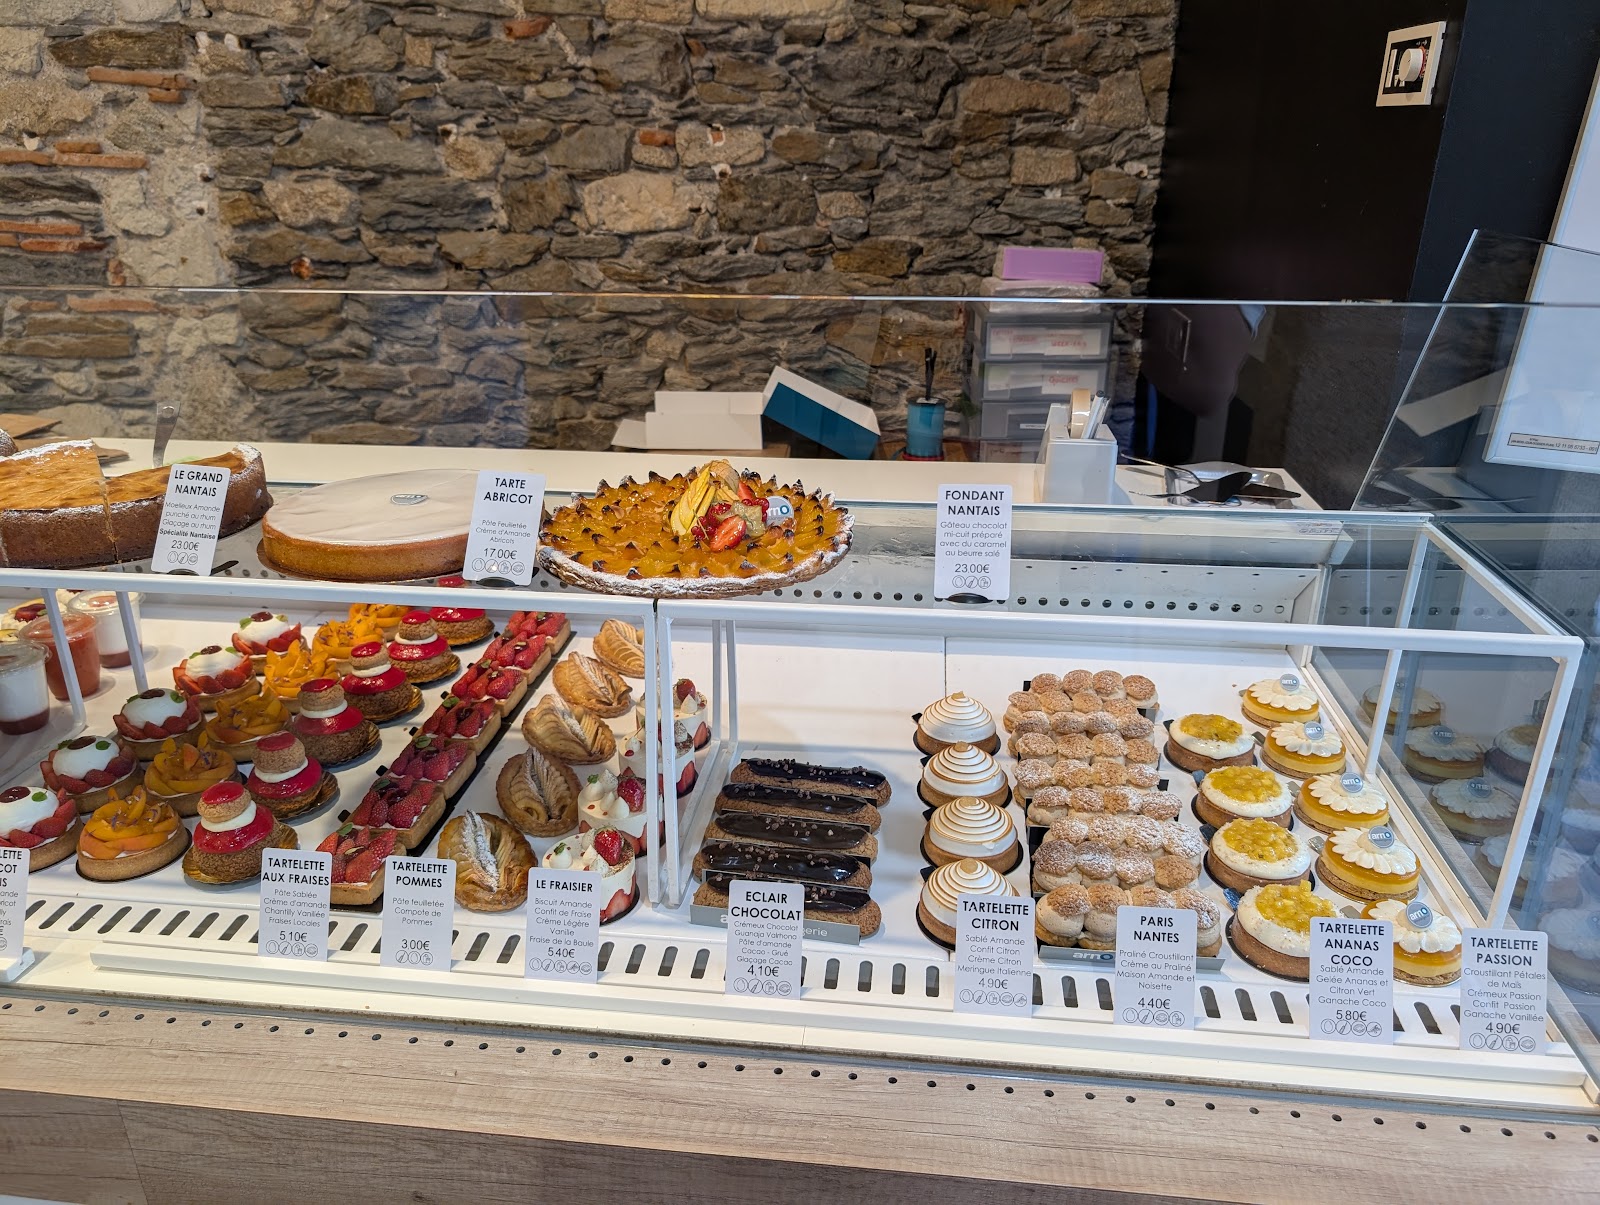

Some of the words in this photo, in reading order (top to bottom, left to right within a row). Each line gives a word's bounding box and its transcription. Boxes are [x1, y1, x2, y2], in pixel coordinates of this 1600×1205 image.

[175, 470, 184, 479] LE
[187, 471, 223, 482] GRAND
[495, 478, 526, 489] TARTE
[175, 485, 217, 497] NANTAIS
[946, 490, 1004, 500] FONDANT
[484, 492, 533, 504] ABRICOT
[193, 504, 220, 512] Amande
[948, 506, 1000, 515] NANTAIS
[163, 519, 189, 528] Glaçage
[498, 521, 527, 529] Feuilletée
[940, 521, 970, 529] Gâteau
[160, 528, 188, 536] Spécialité
[190, 532, 215, 540] Nantaise
[498, 530, 531, 538] d'Amande
[171, 540, 200, 551] 2300€
[490, 536, 514, 544] Abricots
[955, 564, 990, 573] 23.00€
[268, 858, 325, 870] TARTELETTE
[393, 861, 447, 873] TARTELETTE
[262, 872, 285, 882] AUX
[289, 874, 329, 886] FRAISES
[396, 876, 442, 888] POMMES
[536, 880, 546, 889] LE
[550, 881, 593, 892] FRAISIER
[293, 890, 317, 898] Sablée
[746, 891, 788, 904] ECLAIR
[264, 898, 288, 906] Crème
[290, 900, 327, 908] d'amande
[411, 899, 444, 908] feuilletée
[559, 900, 592, 908] Amande
[963, 901, 1029, 916] TARTELETTE
[265, 907, 295, 916] Chantilly
[297, 910, 325, 918] Vanillée
[394, 907, 429, 916] Compote
[535, 907, 557, 915] Confit
[571, 910, 592, 918] Fraise
[731, 906, 801, 920] CHOCOLAT
[1410, 908, 1428, 920] arno
[294, 919, 320, 927] Locales
[402, 917, 432, 926] Pommes
[536, 917, 561, 925] Crème
[564, 919, 589, 928] Légère
[734, 921, 764, 929] Crémeux
[766, 923, 798, 931] Chocolat
[972, 918, 1018, 931] CITRON
[1140, 916, 1174, 927] PARIS
[550, 928, 574, 936] Vanille
[735, 930, 764, 938] Guanaja
[1319, 922, 1384, 935] TARTELETTE
[280, 930, 307, 942] 510€
[529, 936, 550, 944] Fraise
[574, 939, 594, 947] Baule
[966, 934, 988, 943] Sablé
[990, 937, 1025, 946] Amande
[1134, 931, 1179, 943] NANTES
[756, 940, 792, 948] d'amande
[1324, 939, 1379, 951] ANANAS
[1471, 937, 1538, 950] TARTELETTE
[970, 945, 994, 953] Confit
[996, 947, 1020, 955] Citron
[1120, 950, 1146, 958] Praliné
[1149, 952, 1194, 961] Croustillant
[737, 956, 766, 964] Glaçage
[768, 958, 792, 966] Cacao
[968, 955, 995, 964] Crème
[998, 957, 1021, 966] Citron
[1073, 952, 1113, 960] arno
[1331, 955, 1373, 966] COCO
[1476, 953, 1532, 966] PASSION
[957, 965, 995, 974] Meringue
[997, 968, 1031, 977] Italienne
[1121, 960, 1148, 968] Crème
[1164, 962, 1191, 971] Praliné
[1320, 965, 1344, 973] Sablé
[1346, 966, 1384, 975] Amande
[1117, 970, 1145, 978] Maison
[1148, 972, 1184, 981] Amande
[1464, 968, 1512, 978] Croustillant
[1514, 970, 1546, 980] Pétales
[1138, 982, 1172, 990] Noisette
[1316, 975, 1342, 983] Gelée
[1345, 977, 1377, 986] Ananas
[1330, 986, 1354, 995] Citron
[1357, 988, 1375, 996] Vert
[1467, 989, 1507, 998] Crémeux
[1510, 992, 1541, 1000] Passion
[1318, 996, 1359, 1006] Ganache
[1362, 999, 1386, 1007] Coco
[1473, 1000, 1499, 1008] Confit
[1504, 1002, 1535, 1011] Passion
[1464, 1010, 1506, 1020] Ganache
[1509, 1012, 1544, 1022] Vanillée
